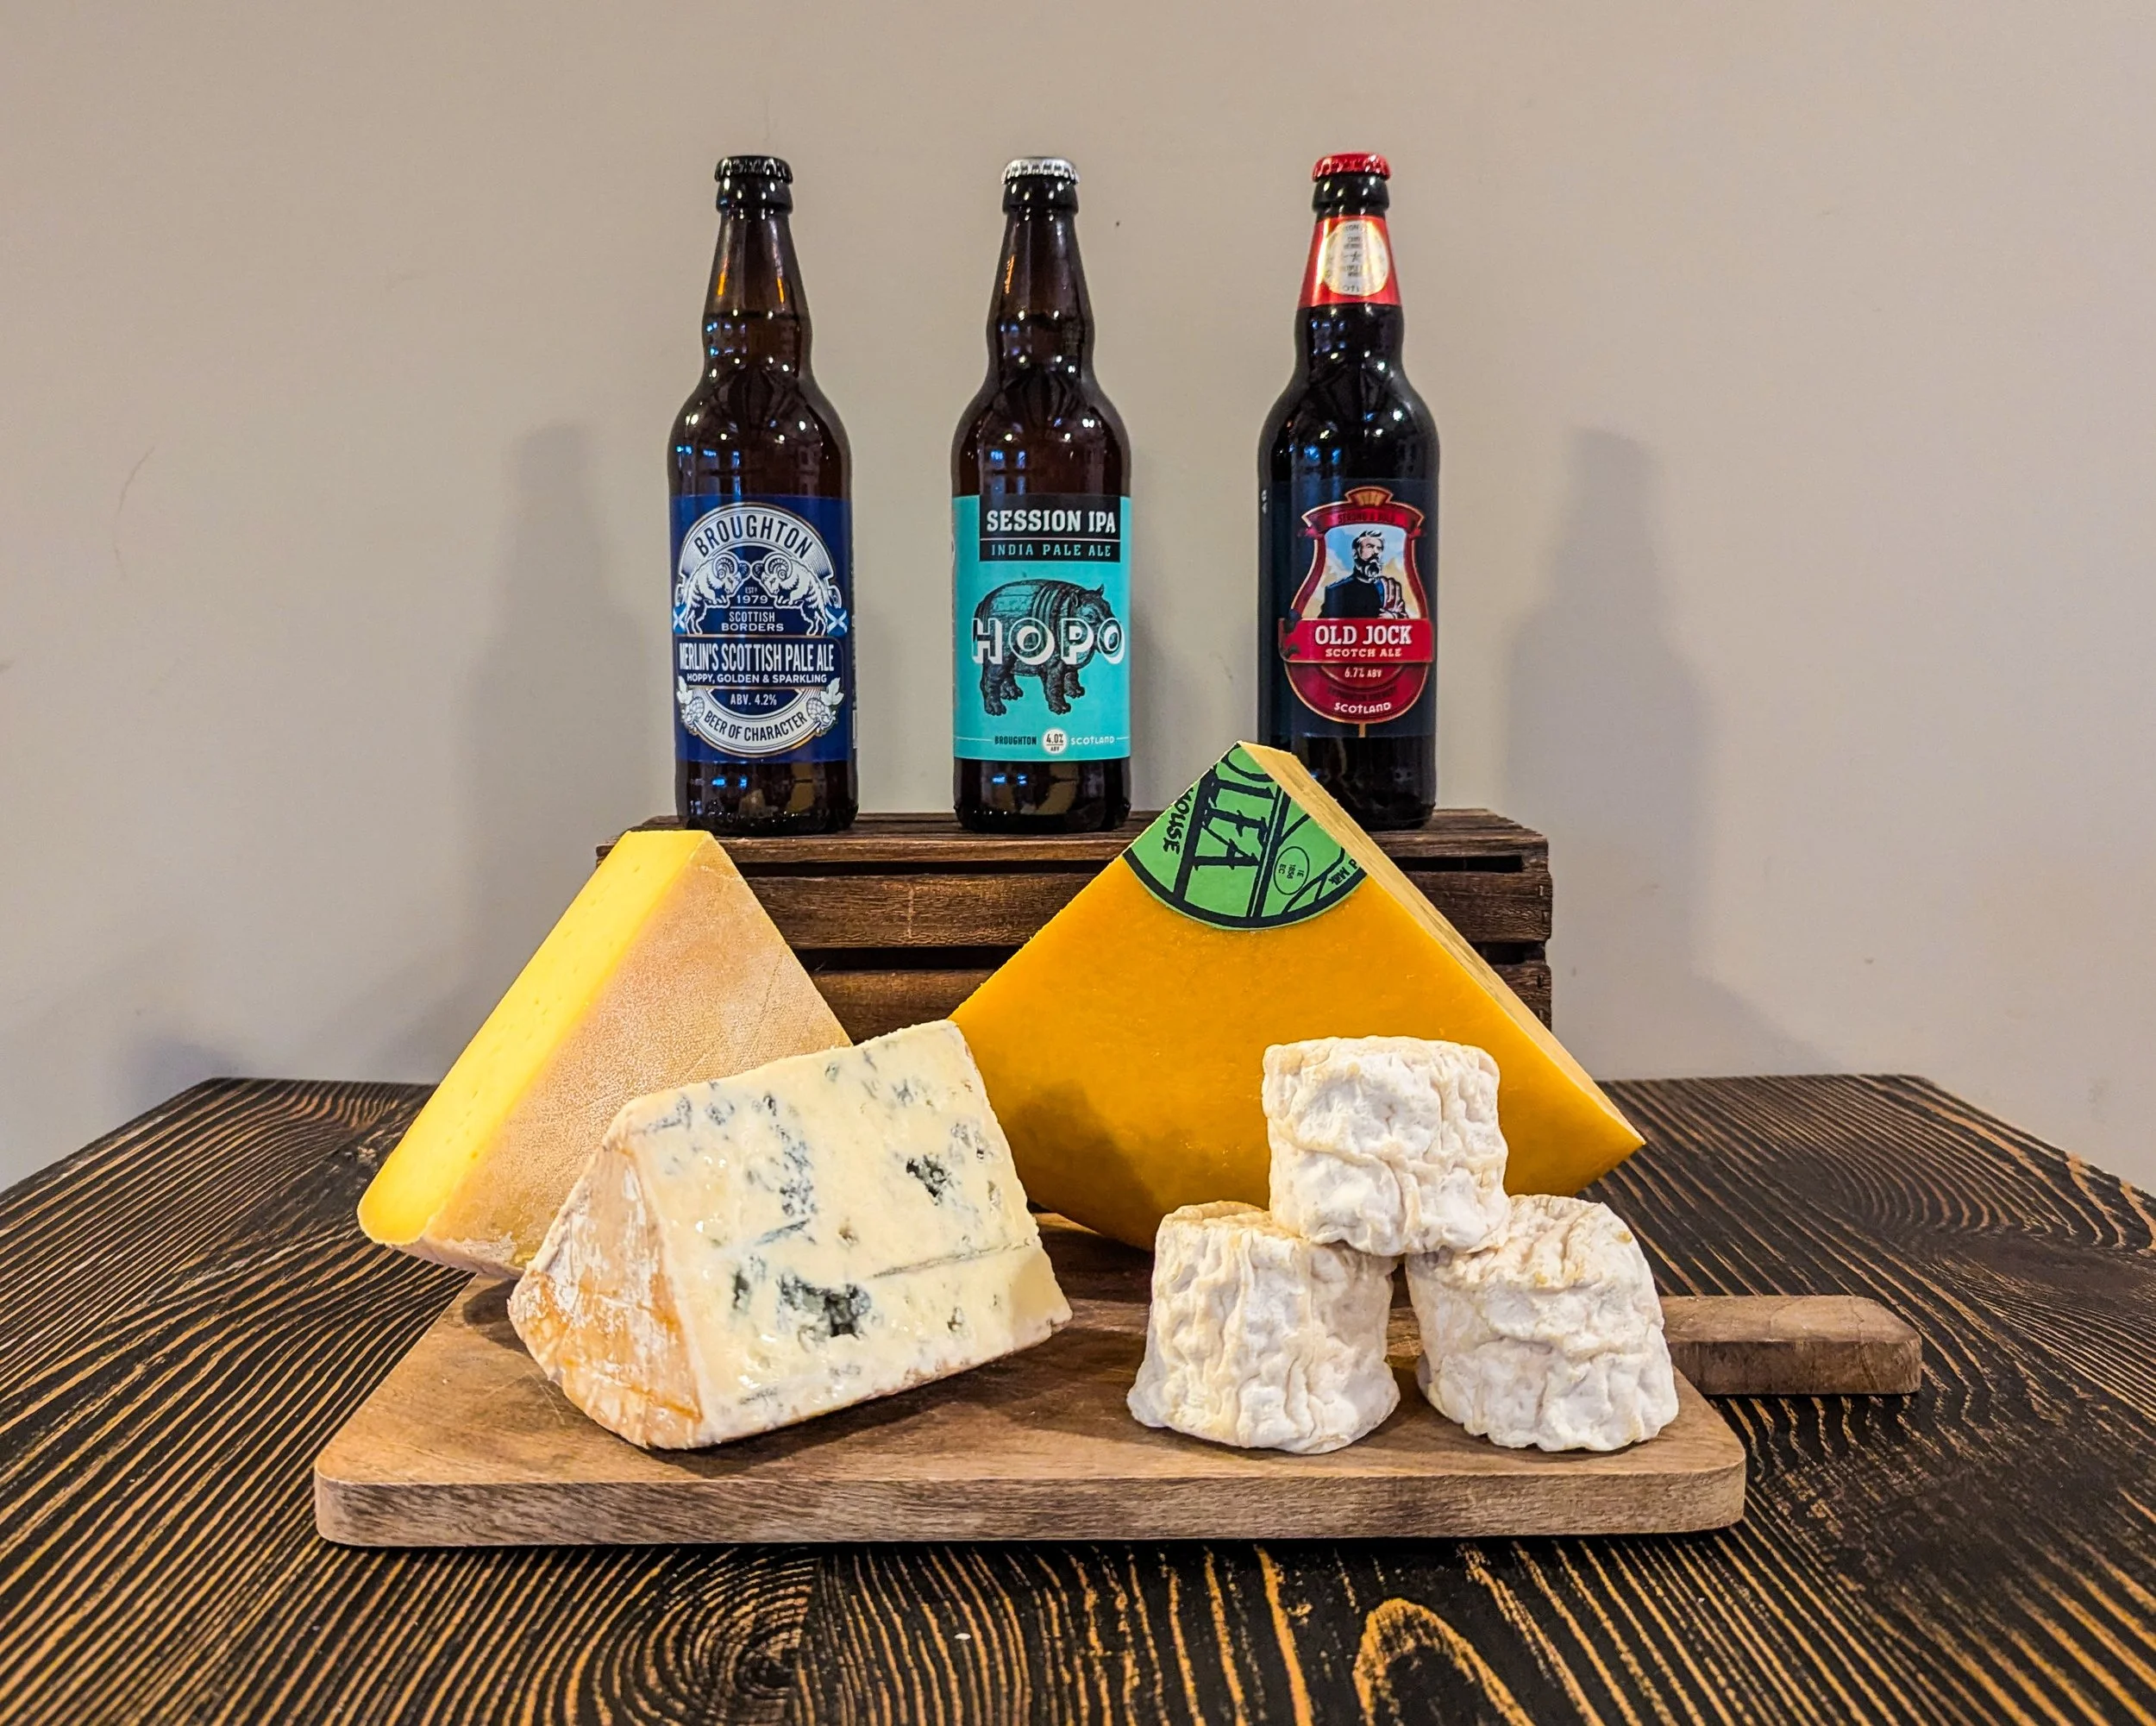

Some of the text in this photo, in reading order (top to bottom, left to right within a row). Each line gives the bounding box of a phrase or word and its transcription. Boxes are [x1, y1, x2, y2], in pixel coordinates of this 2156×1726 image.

[986, 510, 1116, 533] SESSION IPA
[694, 515, 813, 559] BROUGHTON
[992, 543, 1111, 556] INDIA PALE ALE
[736, 595, 768, 604] 1979
[729, 611, 775, 623] SCOTTISH
[721, 623, 785, 631] BORDERS
[1314, 625, 1413, 645] OLD JOCK
[971, 618, 1125, 665] HOPO
[721, 643, 782, 672] SCOTTISH
[786, 643, 814, 672] PALE
[816, 643, 835, 672] ALE
[1325, 648, 1402, 657] SCOTCH ALE
[686, 673, 827, 684] HOPPY, GOLDEN & SPARKLING
[1367, 668, 1382, 678] ABV
[730, 694, 777, 706] ABV. 4.2%
[1334, 702, 1392, 714] SCOTLAND
[704, 710, 808, 742] BEER OF CHARACTER
[994, 736, 1037, 745] BROUGHTON
[1070, 736, 1115, 745] SCOTLAND
[1278, 863, 1287, 875] EC
[1296, 869, 1305, 878] IE
